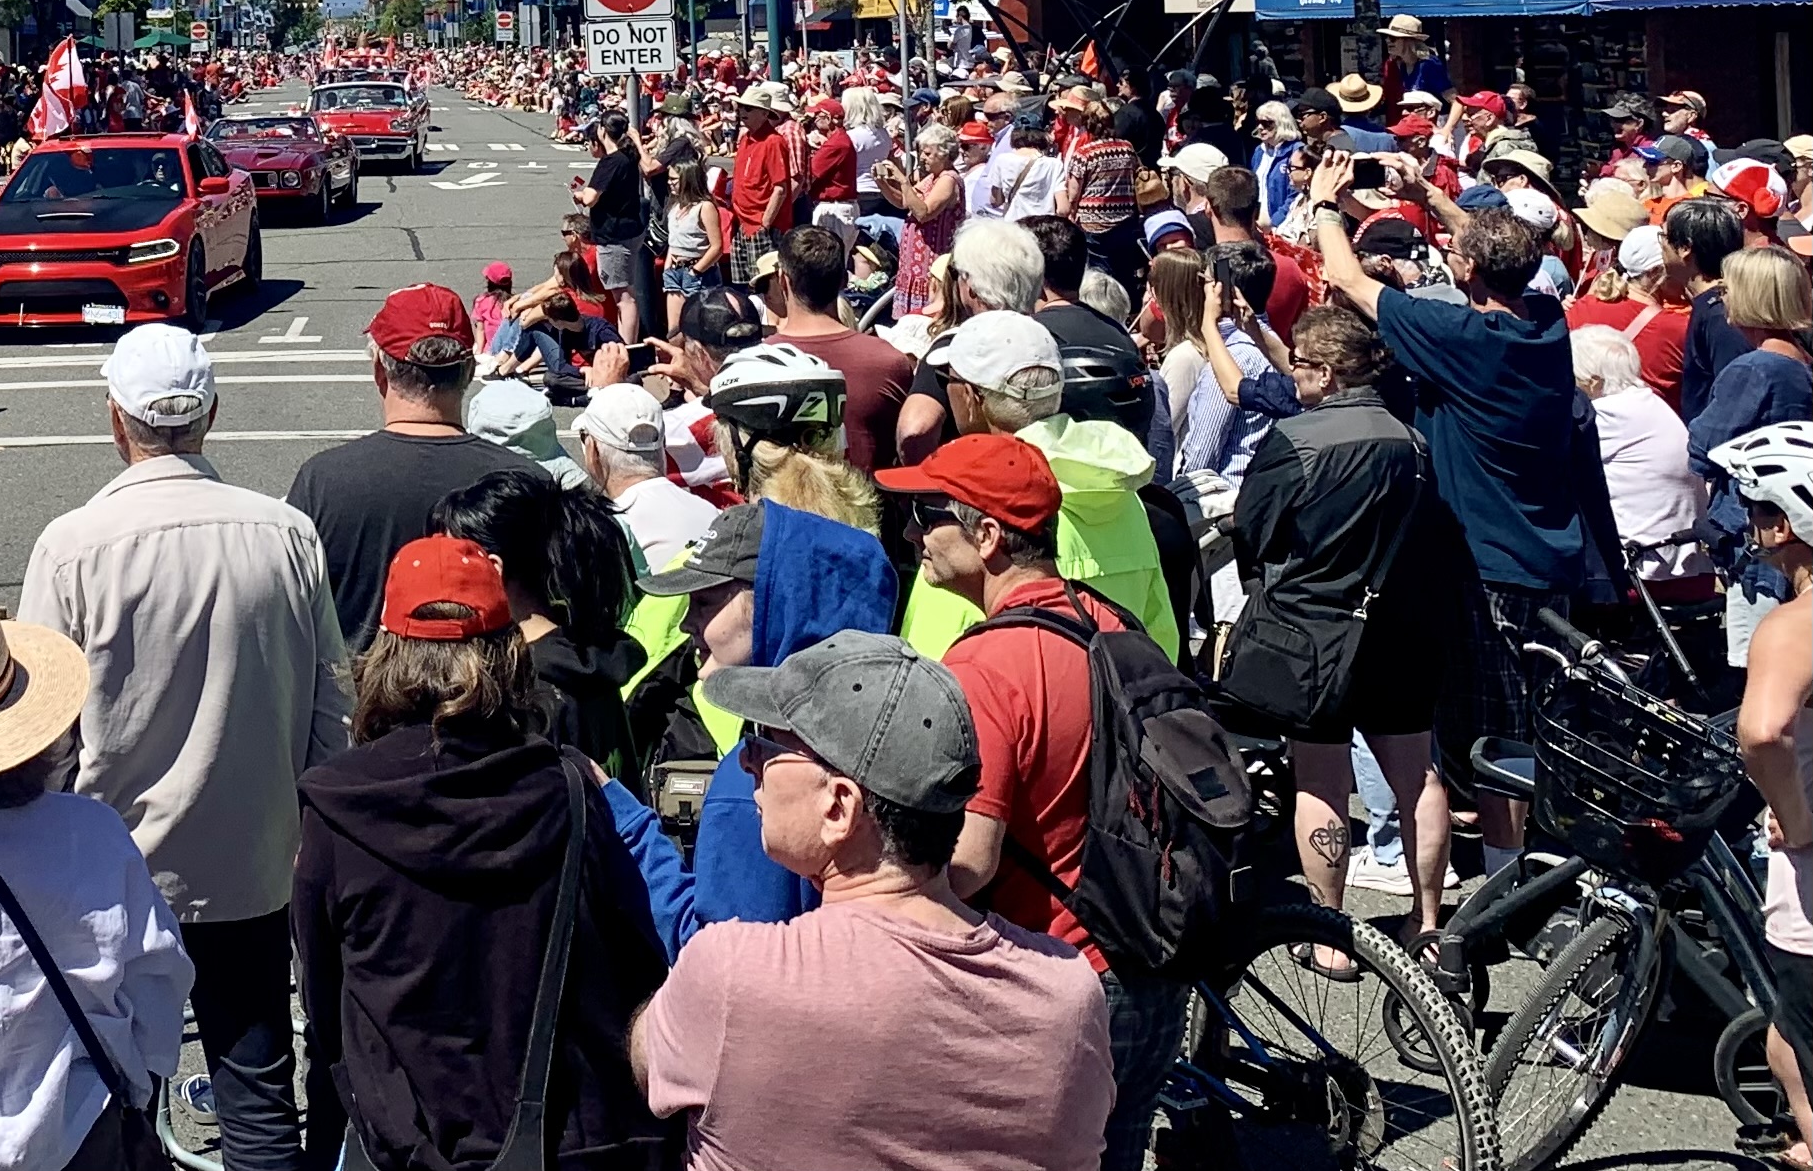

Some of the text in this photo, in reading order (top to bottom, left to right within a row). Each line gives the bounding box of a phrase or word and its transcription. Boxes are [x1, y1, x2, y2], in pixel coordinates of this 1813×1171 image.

[593, 27, 668, 45] DO NOT
[601, 47, 662, 65] ENTER
